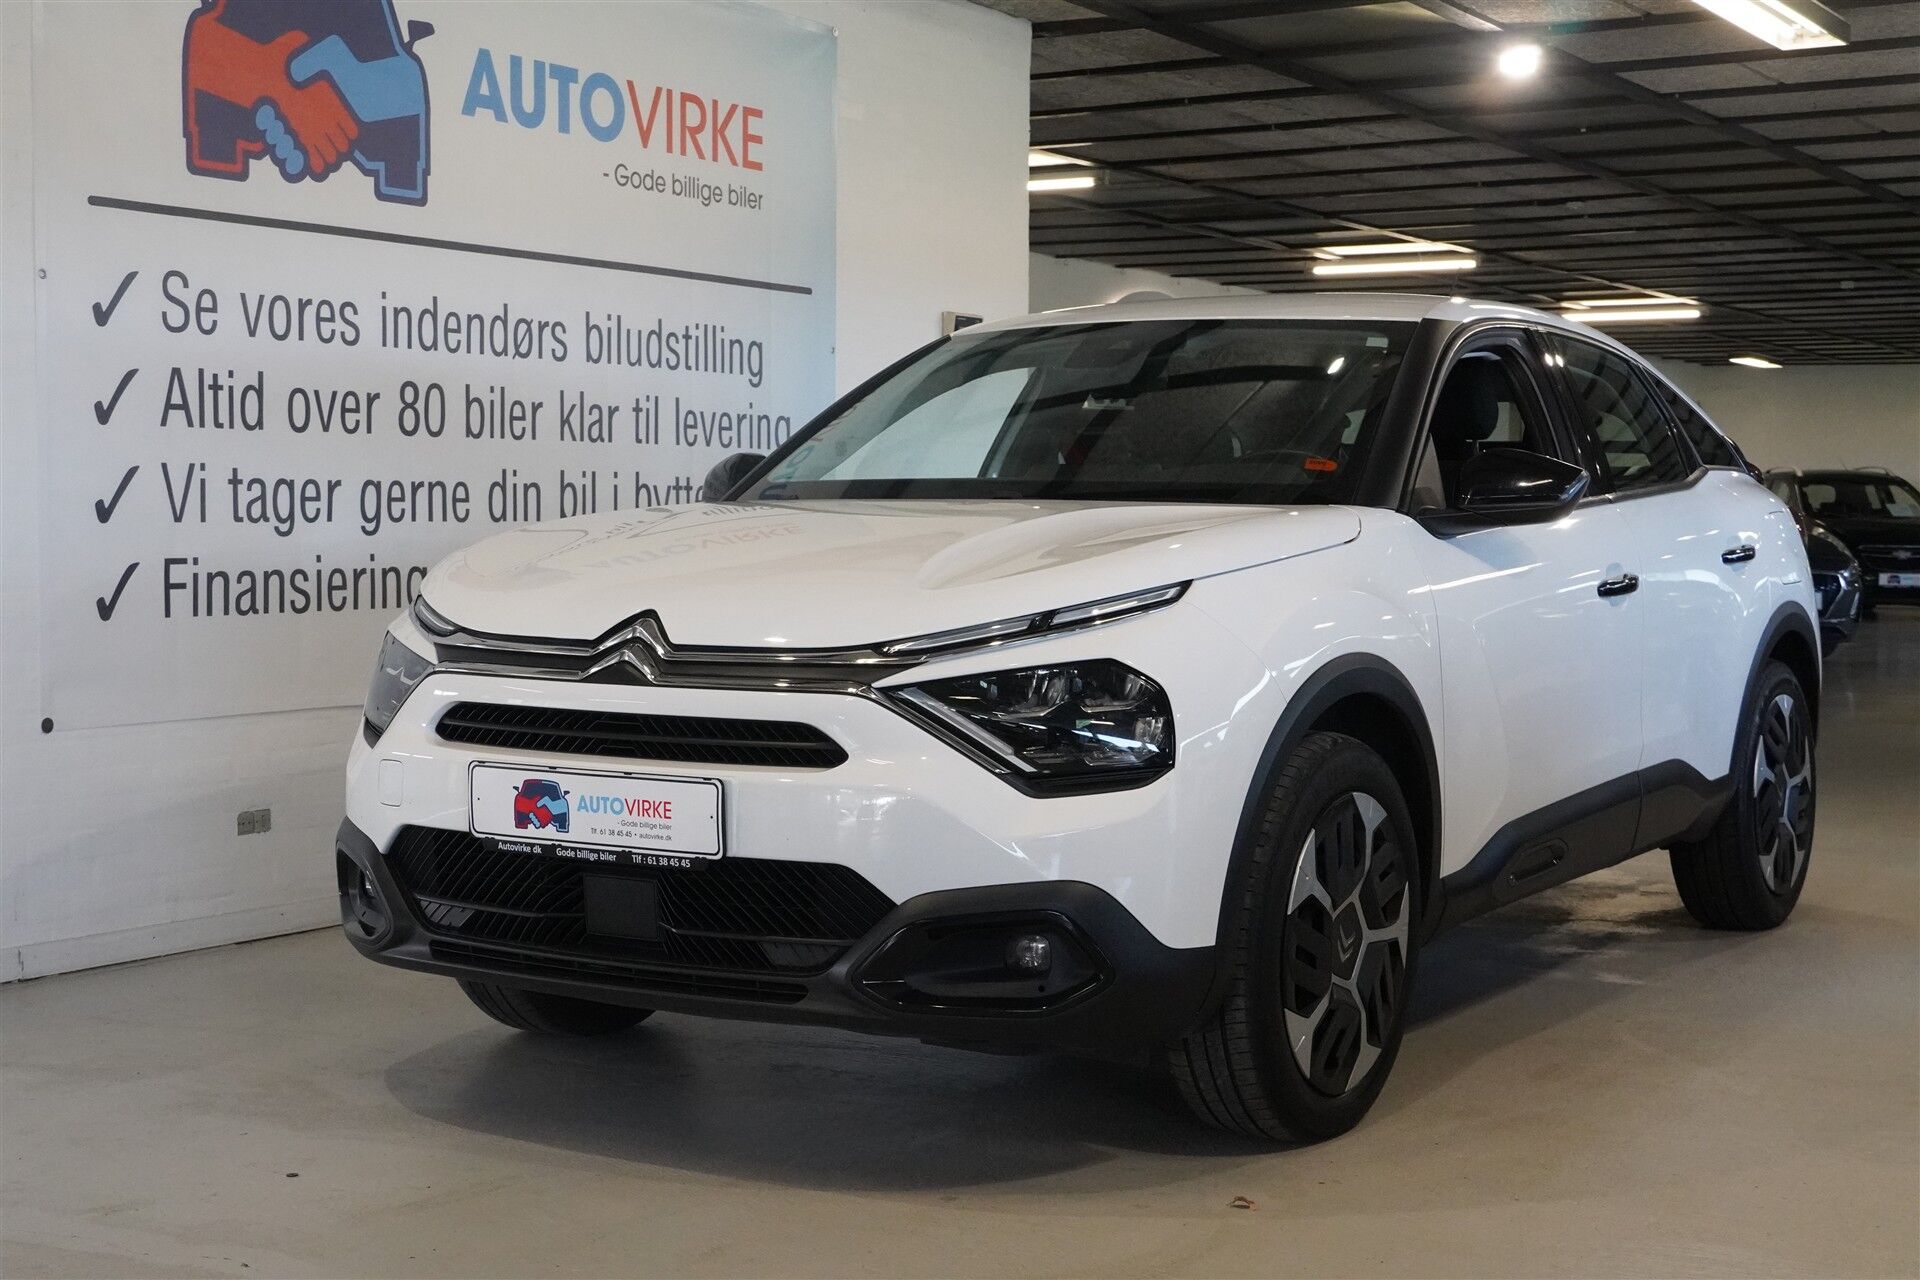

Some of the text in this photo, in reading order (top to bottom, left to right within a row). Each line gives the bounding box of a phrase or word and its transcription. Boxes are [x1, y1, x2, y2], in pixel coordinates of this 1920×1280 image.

[461, 47, 763, 171] AUTOVIRKE
[614, 163, 666, 193] Gode
[672, 173, 723, 207] billige
[728, 184, 763, 210] biler
[161, 269, 763, 388] Se vores indendørs biludstilling
[160, 366, 791, 450] Altid over 80 biler klar til levering
[161, 462, 207, 523] Vi
[227, 467, 342, 537] tager
[360, 479, 470, 537] gerne
[488, 468, 541, 523] din
[560, 469, 596, 519] bil
[613, 471, 618, 511] i
[577, 794, 672, 819] AUTOVIRKE
[621, 820, 638, 828] Gode
[639, 821, 657, 830] billige
[659, 822, 672, 831] biler
[498, 841, 531, 854] Autovirke
[556, 847, 575, 858] Gode
[577, 849, 598, 861] billige
[600, 852, 616, 862] biler
[647, 857, 656, 865] 61
[659, 858, 668, 866] 38
[670, 859, 679, 867] 45
[680, 860, 691, 868] 45
[616, 829, 624, 837] 45
[625, 830, 632, 838] 45
[639, 832, 672, 841] autovirke.dk
